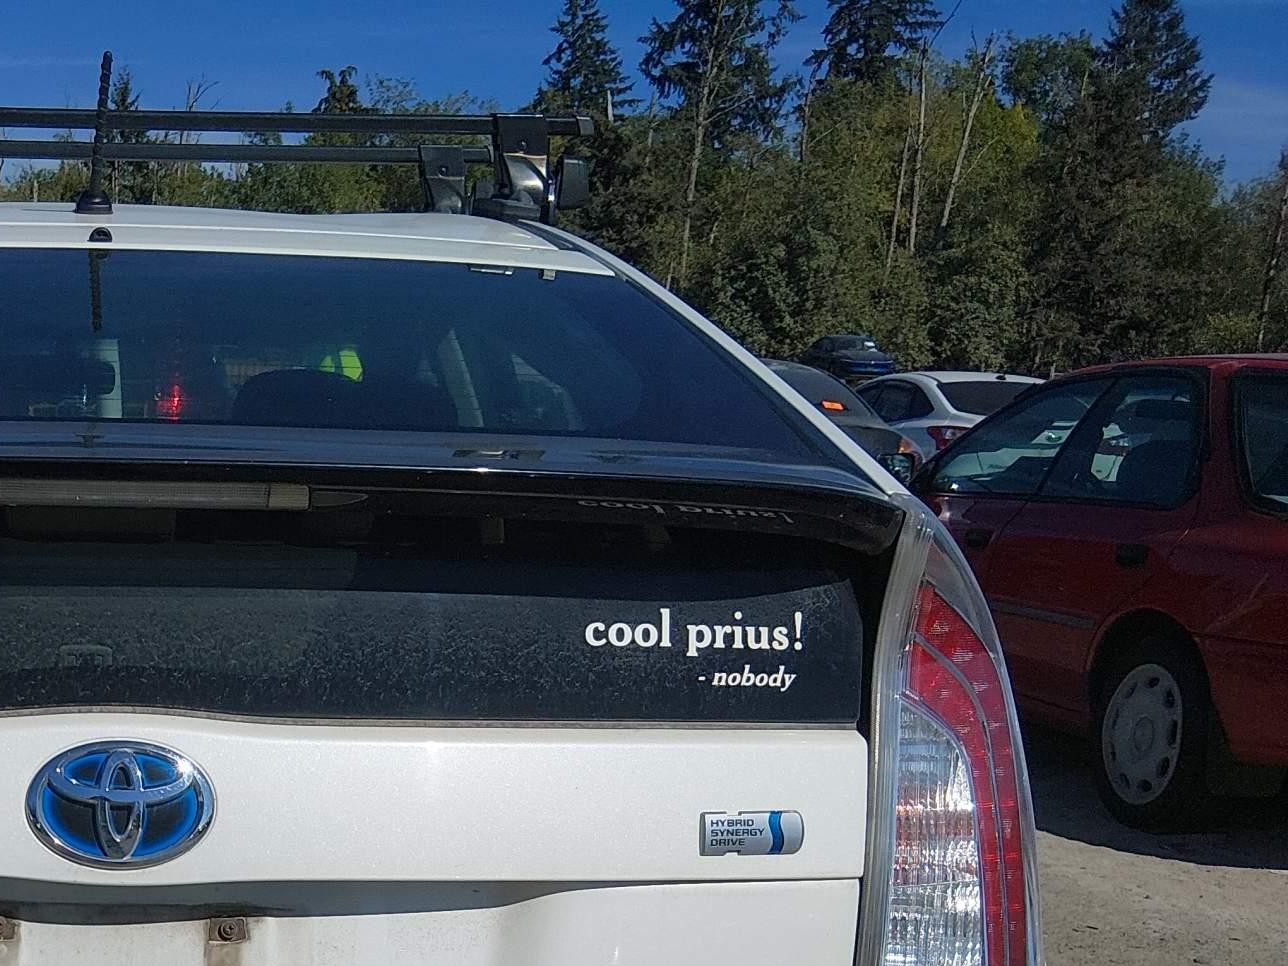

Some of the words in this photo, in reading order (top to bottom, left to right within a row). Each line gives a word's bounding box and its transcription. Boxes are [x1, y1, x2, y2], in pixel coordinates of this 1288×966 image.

[585, 607, 672, 648] cool
[686, 611, 803, 657] prius!
[711, 665, 797, 692] nobody
[710, 819, 755, 828] HYBRID
[710, 828, 766, 838] SYNERGY
[710, 838, 746, 847] DRIVE
